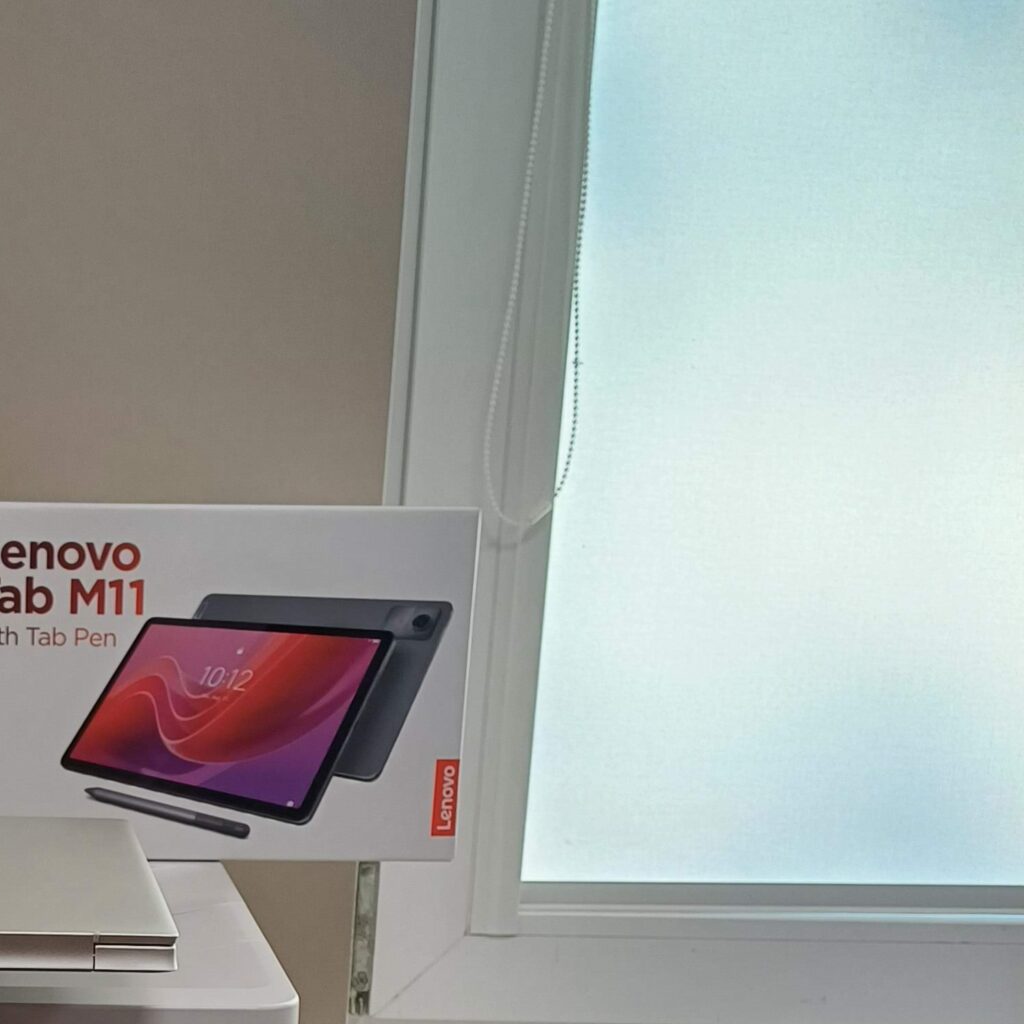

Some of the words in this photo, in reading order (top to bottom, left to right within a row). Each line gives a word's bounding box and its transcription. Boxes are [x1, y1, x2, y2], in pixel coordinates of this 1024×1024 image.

[69, 578, 145, 616] M11
[25, 626, 67, 647] Tab
[74, 627, 117, 648] Pen
[199, 665, 254, 692] 10:12
[437, 764, 457, 832] Lenovo
